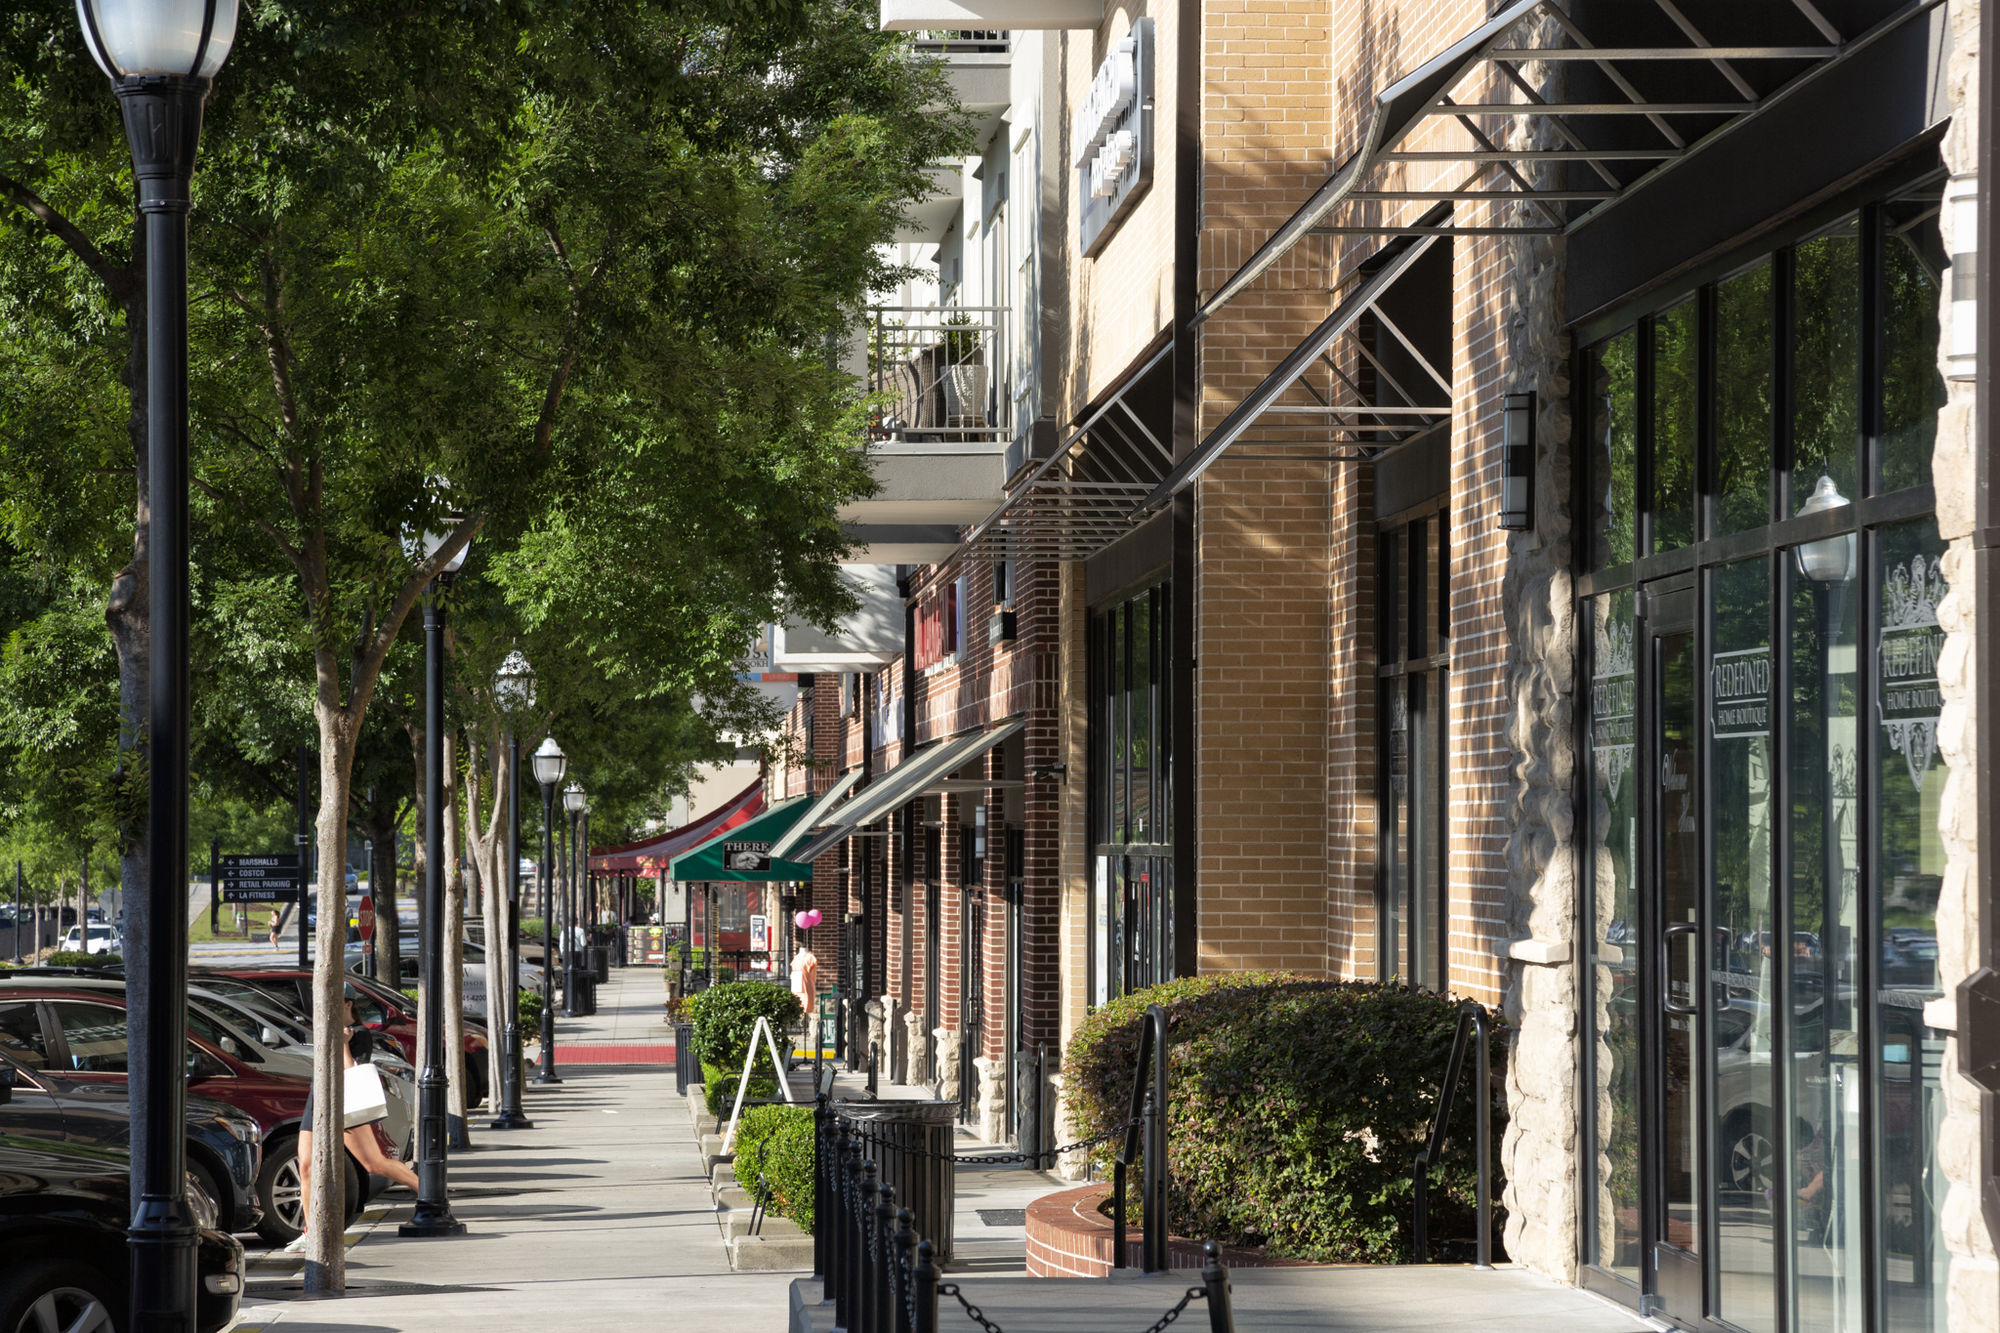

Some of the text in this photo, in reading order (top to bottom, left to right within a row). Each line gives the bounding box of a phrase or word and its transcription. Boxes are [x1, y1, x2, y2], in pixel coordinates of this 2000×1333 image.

[1715, 659, 1770, 698] REDEFINED
[1593, 680, 1635, 715] REDEFINED
[1887, 691, 1911, 710] HOME
[1718, 706, 1767, 726] HOME BOUTIQUE
[724, 842, 770, 851] THERE
[239, 858, 279, 866] MARSHALLS
[239, 869, 265, 877] COSTCO
[239, 880, 291, 888] RETAIL PARKING
[248, 891, 276, 899] FITNESS
[359, 910, 373, 927] STOP
